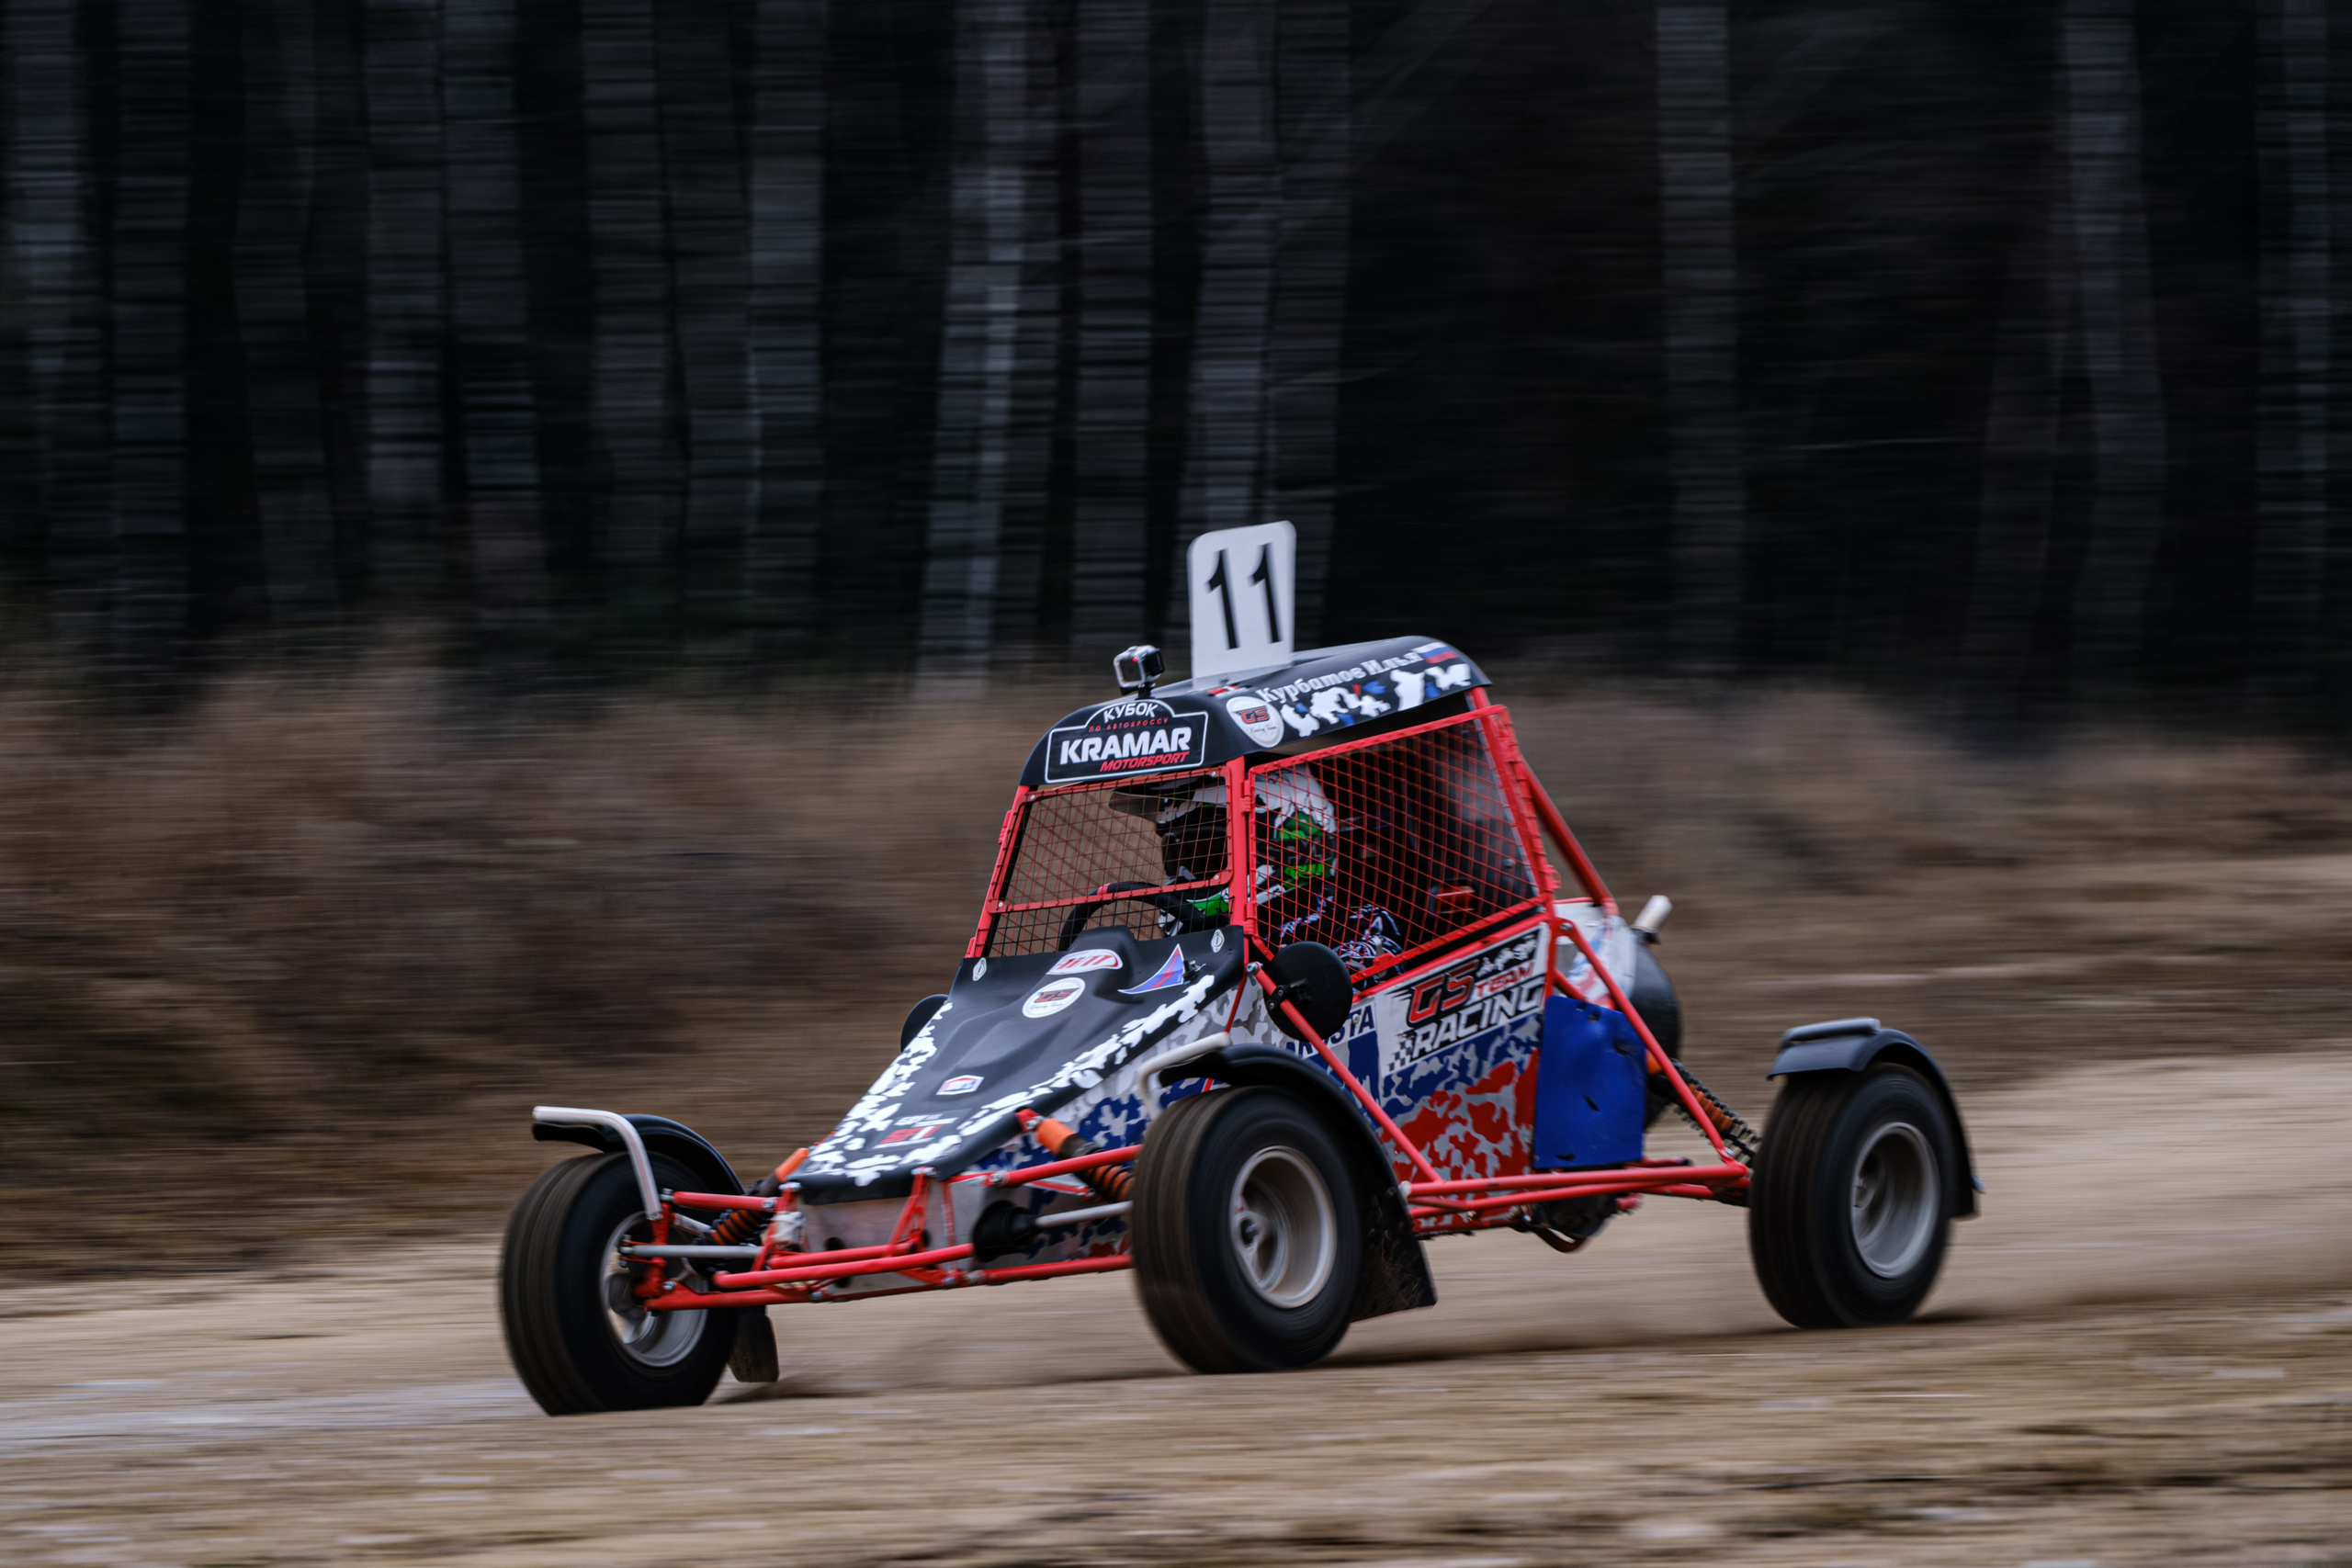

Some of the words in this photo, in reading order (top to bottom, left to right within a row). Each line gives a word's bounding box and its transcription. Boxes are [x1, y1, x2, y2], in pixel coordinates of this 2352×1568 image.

[1205, 542, 1283, 649] 11
[1103, 703, 1159, 723] КУБОК
[1106, 717, 1169, 731] АВТОКРОССУ
[1060, 727, 1192, 765] KRAMAR
[1100, 751, 1190, 773] MOTORSPORT
[1408, 959, 1480, 1023] GS
[1476, 962, 1534, 998] TEAM
[1412, 976, 1545, 1058] RACING
